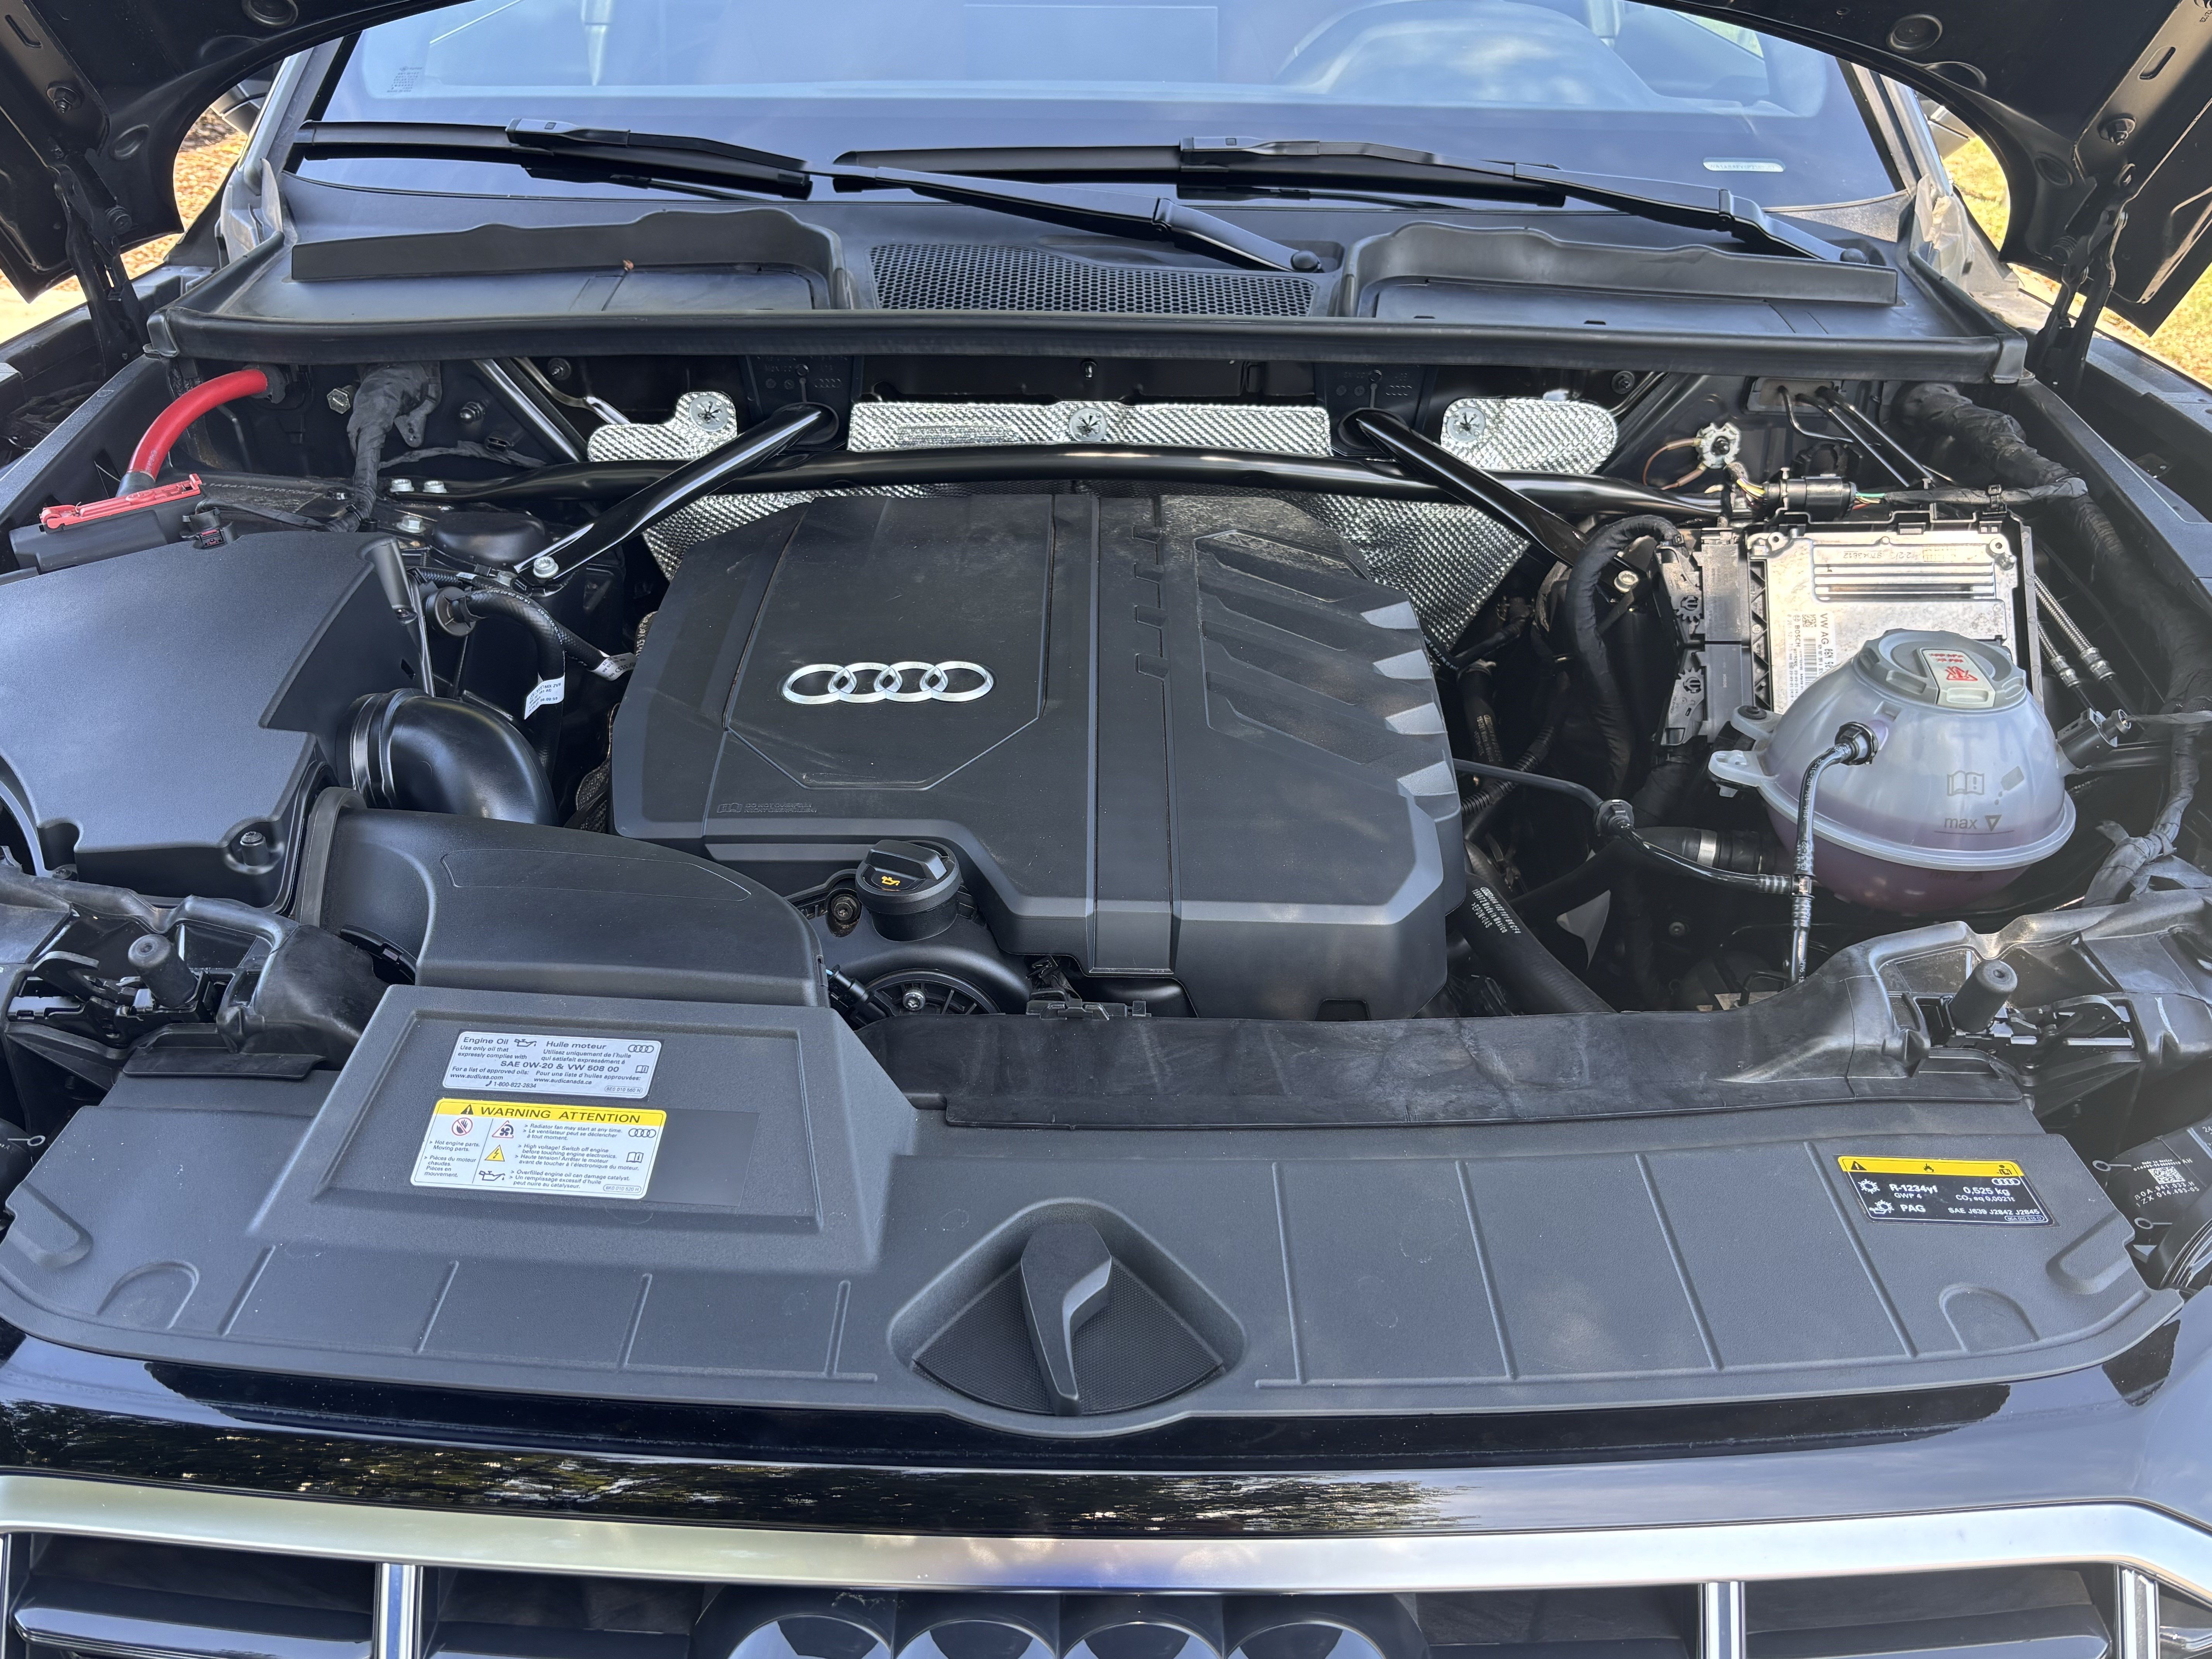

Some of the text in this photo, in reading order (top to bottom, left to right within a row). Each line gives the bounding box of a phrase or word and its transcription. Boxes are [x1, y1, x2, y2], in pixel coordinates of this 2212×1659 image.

[1820, 613, 1829, 629] VW
[1820, 631, 1829, 645] AG
[1944, 817, 1978, 830] max
[1492, 916, 1508, 934] Mexico
[481, 1106, 640, 1123] WARNING ATTENTION
[1889, 1183, 2011, 1196] R-1234yf 0,525 kg
[1899, 1204, 1927, 1213] PAG
